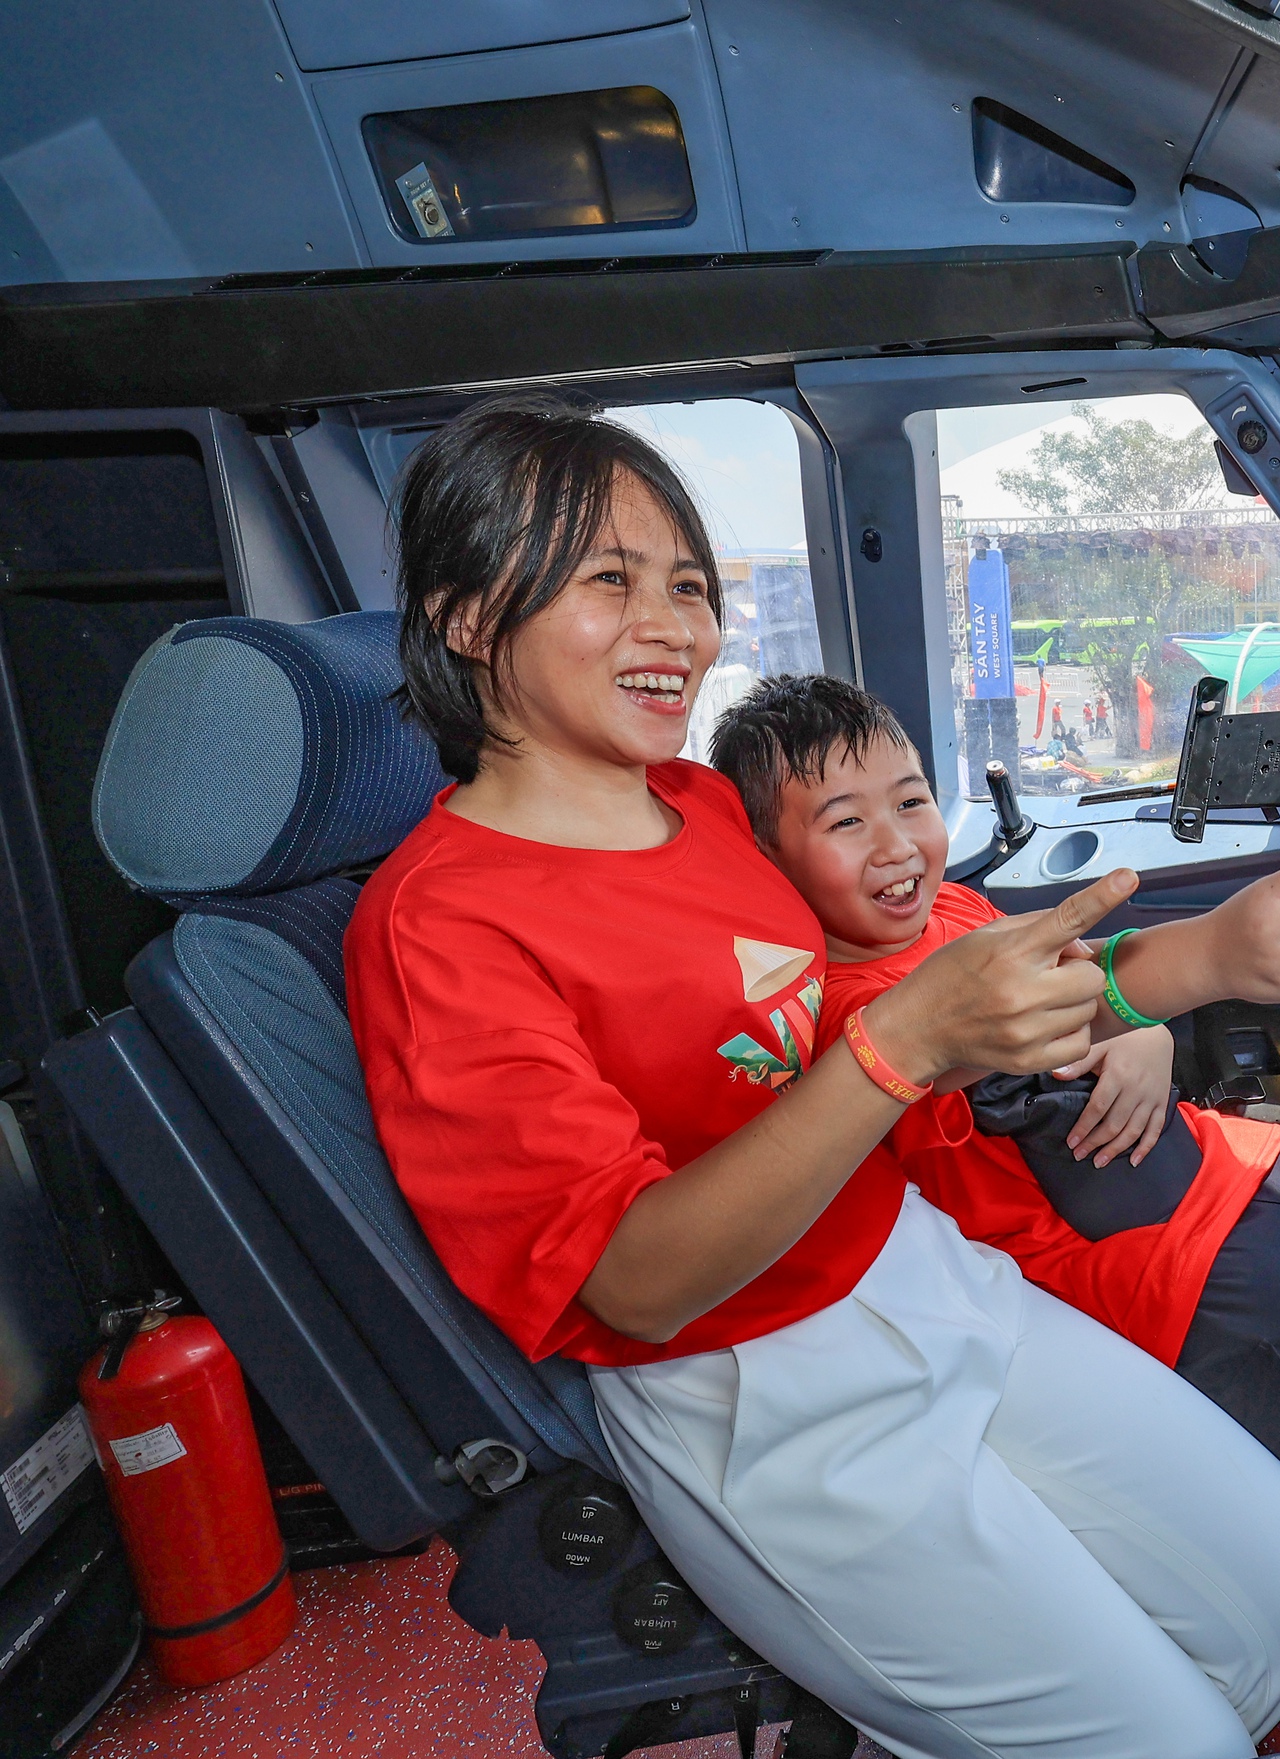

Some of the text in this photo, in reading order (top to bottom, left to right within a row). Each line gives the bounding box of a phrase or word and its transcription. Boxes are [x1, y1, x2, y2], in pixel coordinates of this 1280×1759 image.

[972, 603, 989, 679] SÂN TÂY
[990, 612, 1001, 680] WEST SQUARE
[581, 1510, 595, 1520] UP
[561, 1531, 605, 1545] LUMBAR
[565, 1553, 591, 1564] DOWN
[652, 1598, 669, 1607] AFT
[633, 1616, 677, 1629] LUMBAR
